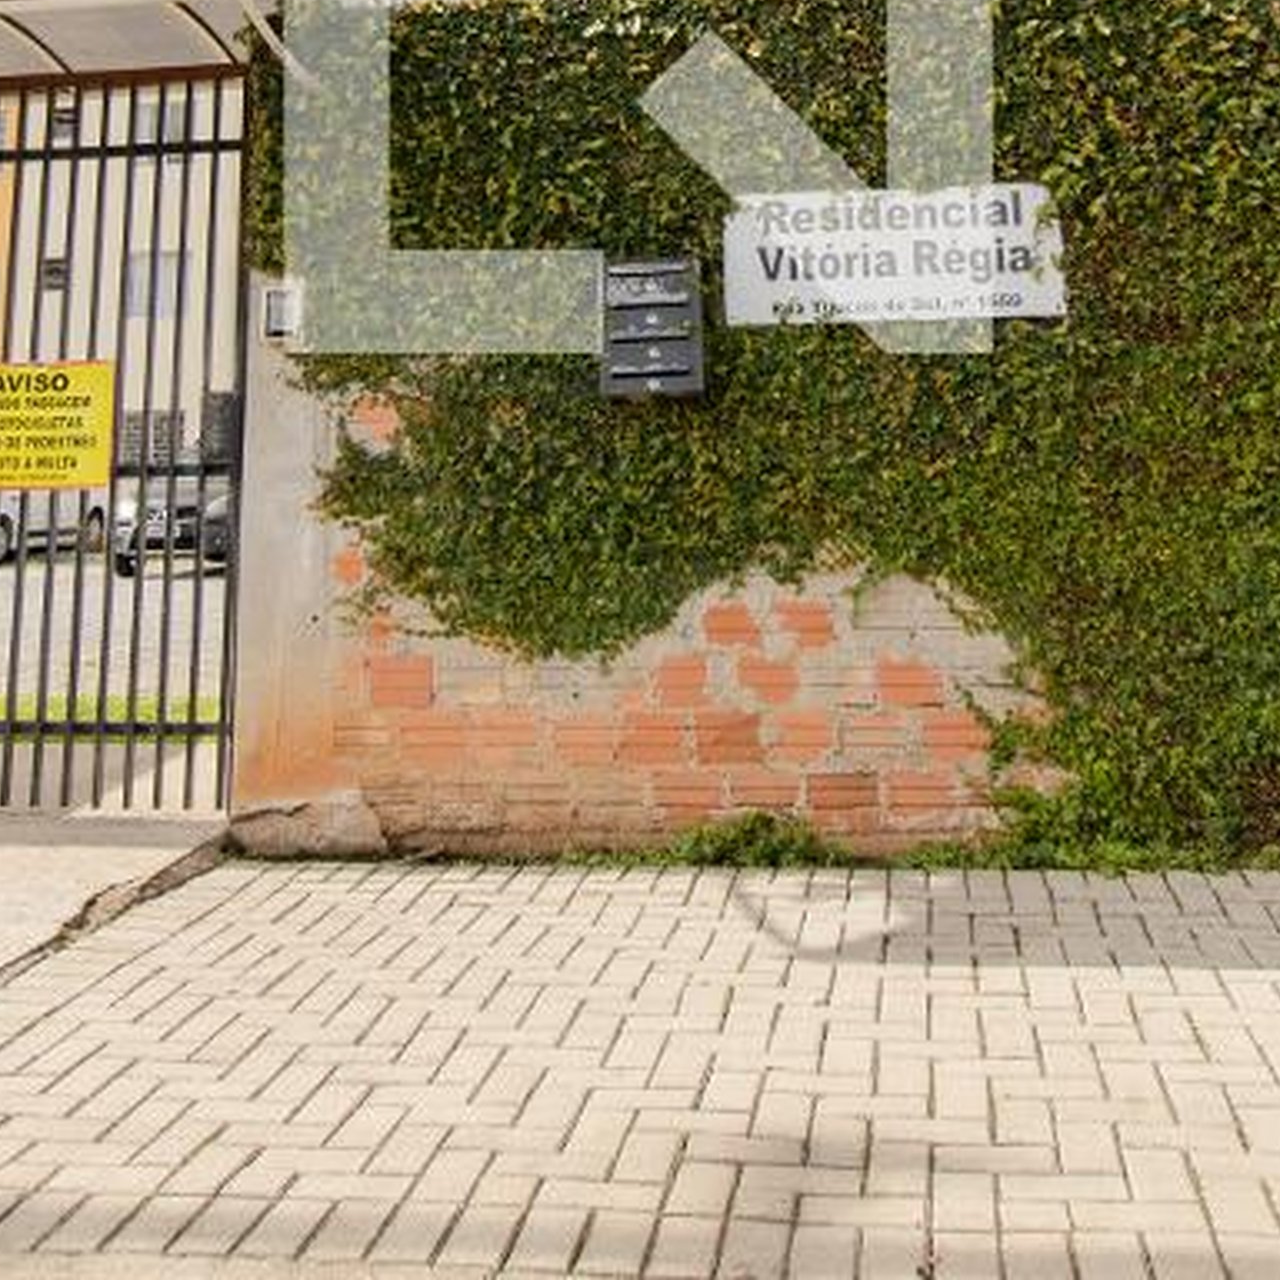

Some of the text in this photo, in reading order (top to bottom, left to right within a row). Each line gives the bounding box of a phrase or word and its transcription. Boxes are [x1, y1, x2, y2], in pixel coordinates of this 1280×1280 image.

[760, 191, 1021, 234] Residencial
[757, 236, 1032, 284] Vitória Régia
